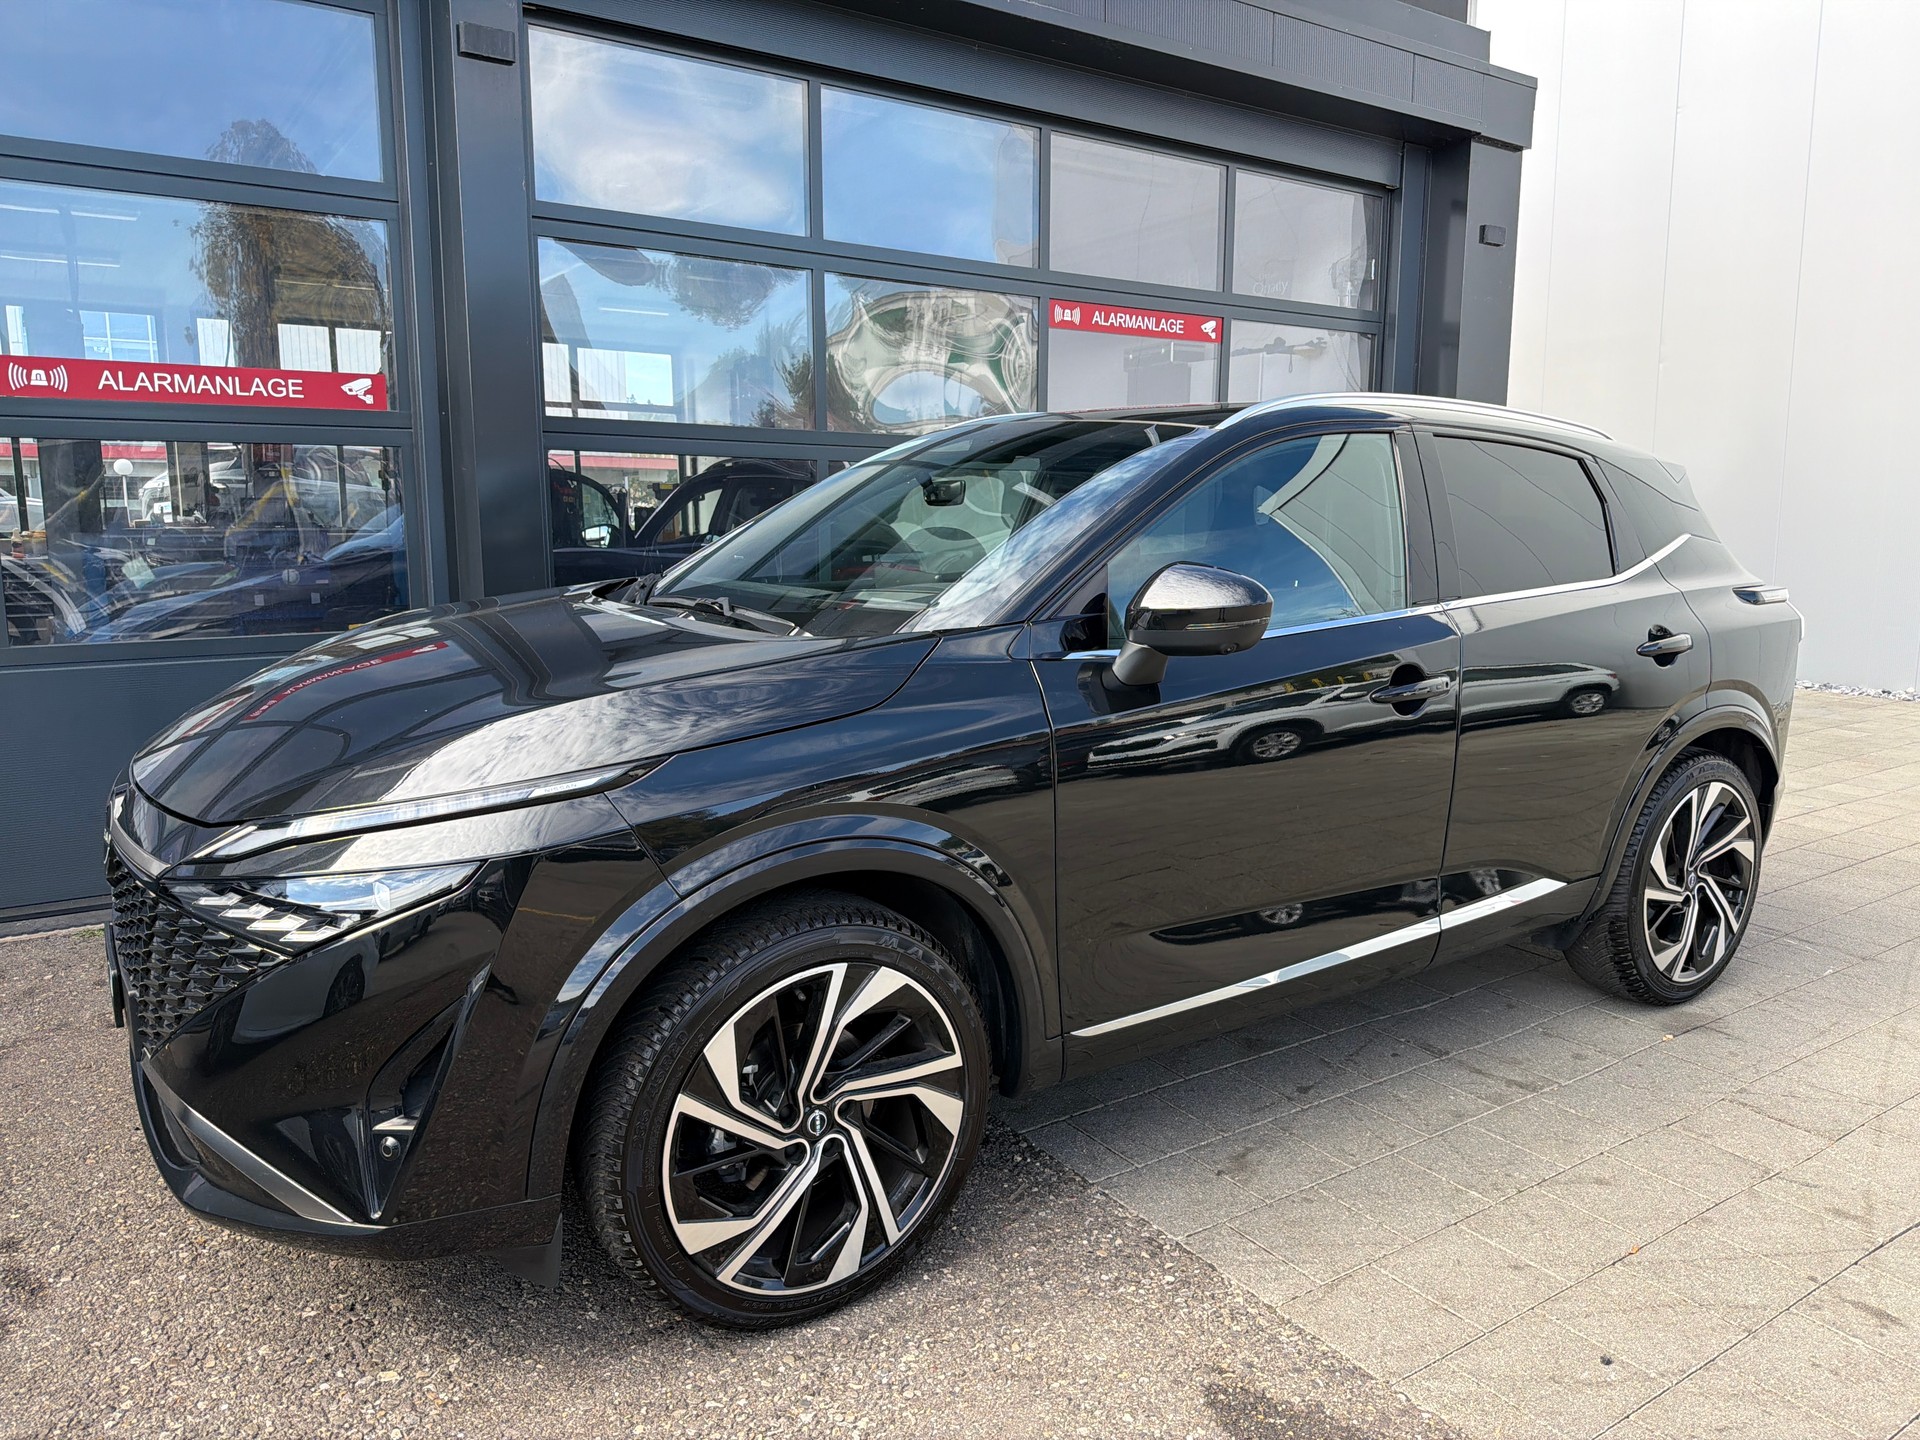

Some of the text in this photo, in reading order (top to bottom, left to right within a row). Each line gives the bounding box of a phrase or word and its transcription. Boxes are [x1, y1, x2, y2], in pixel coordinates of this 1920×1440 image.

[1092, 311, 1184, 334] ALARMANLAGE
[98, 370, 304, 398] ALARMANLAGE
[544, 783, 577, 793] NISSAN
